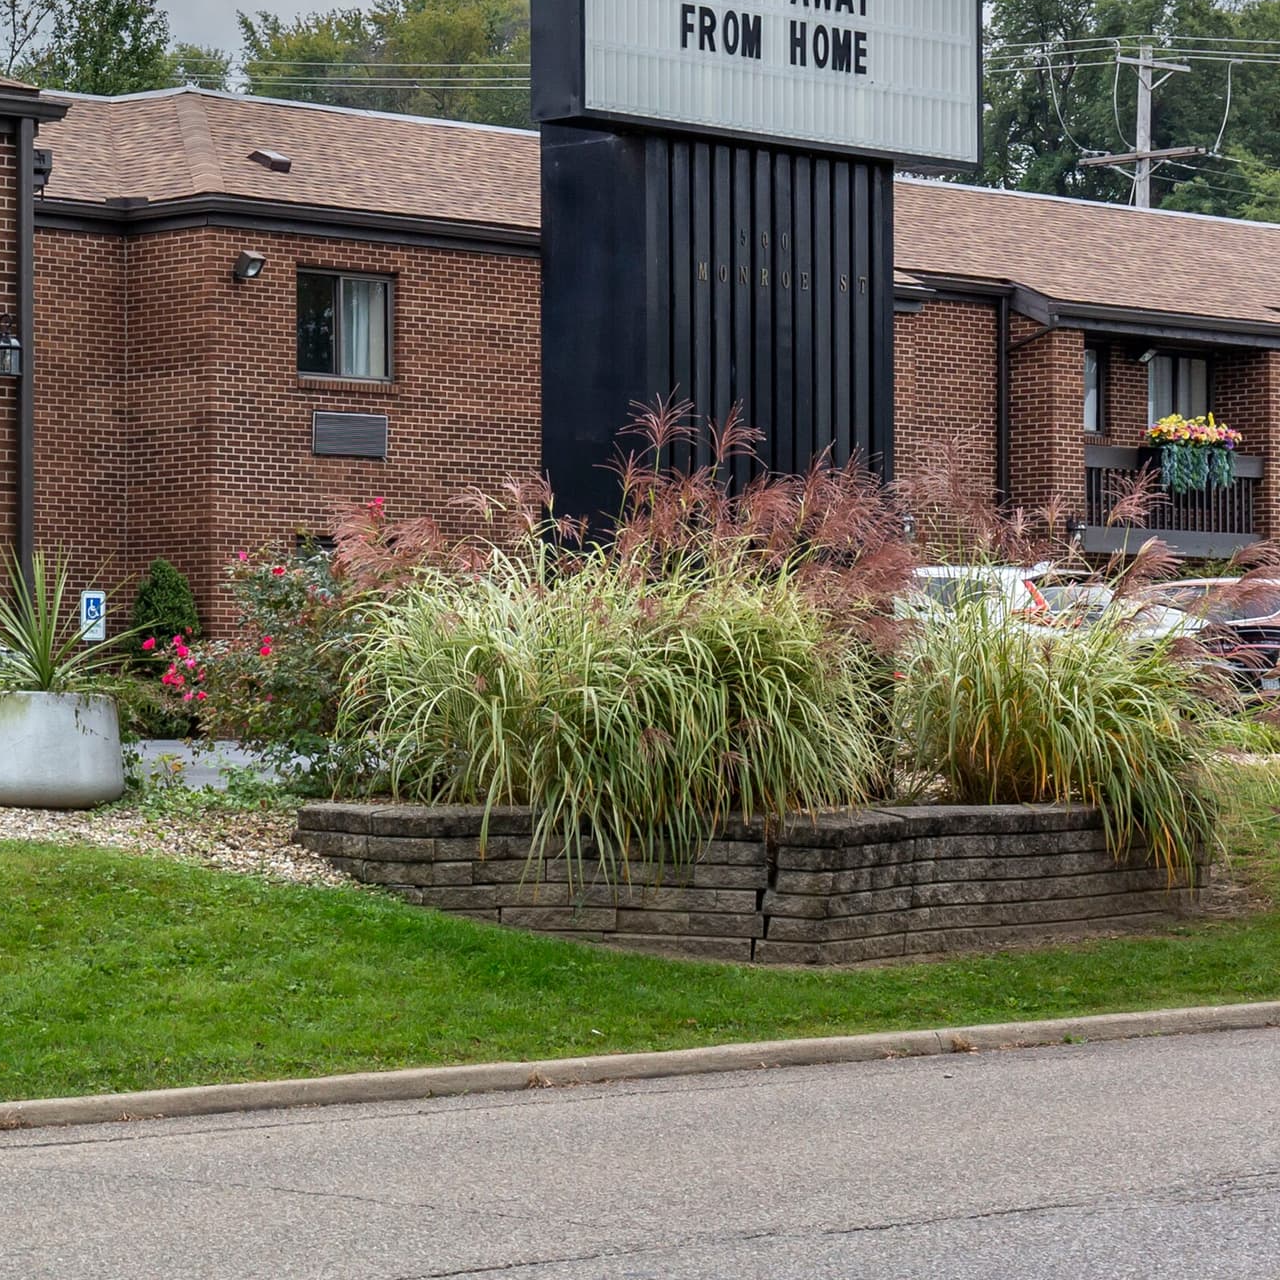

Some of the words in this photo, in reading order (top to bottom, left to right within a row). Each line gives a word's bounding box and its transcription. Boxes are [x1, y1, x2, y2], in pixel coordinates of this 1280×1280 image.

[680, 3, 762, 60] FROM
[789, 19, 867, 75] HOME
[740, 229, 789, 250] 500
[697, 261, 809, 291] MONROE
[839, 274, 868, 294] ST
